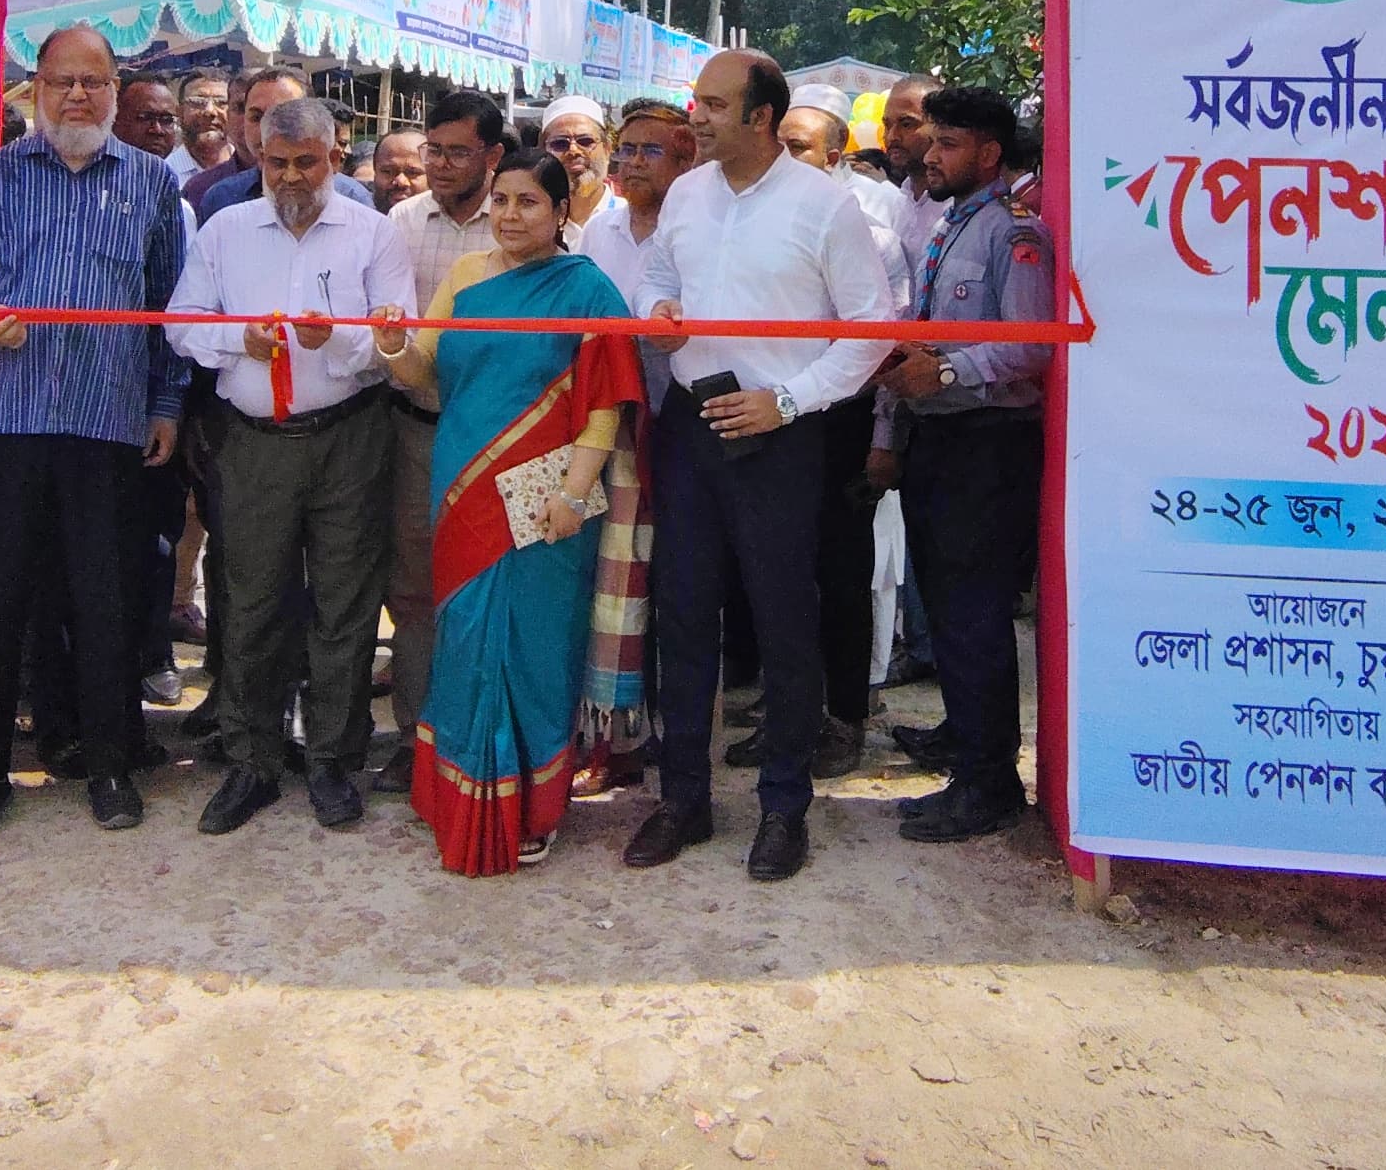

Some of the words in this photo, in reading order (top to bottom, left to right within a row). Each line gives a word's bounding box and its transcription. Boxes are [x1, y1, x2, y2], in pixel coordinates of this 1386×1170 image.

[1150, 489, 1272, 526] ২৪-২৫
[1283, 494, 1356, 538] জুন,
[1246, 591, 1367, 629] আয়োজনে
[1135, 628, 1213, 671] জেলা
[1224, 631, 1345, 689] প্রশাসন,
[1232, 697, 1381, 742] সহযোগিতায়
[1130, 740, 1231, 797] জাতীয়
[1245, 759, 1356, 805] পেনশন
